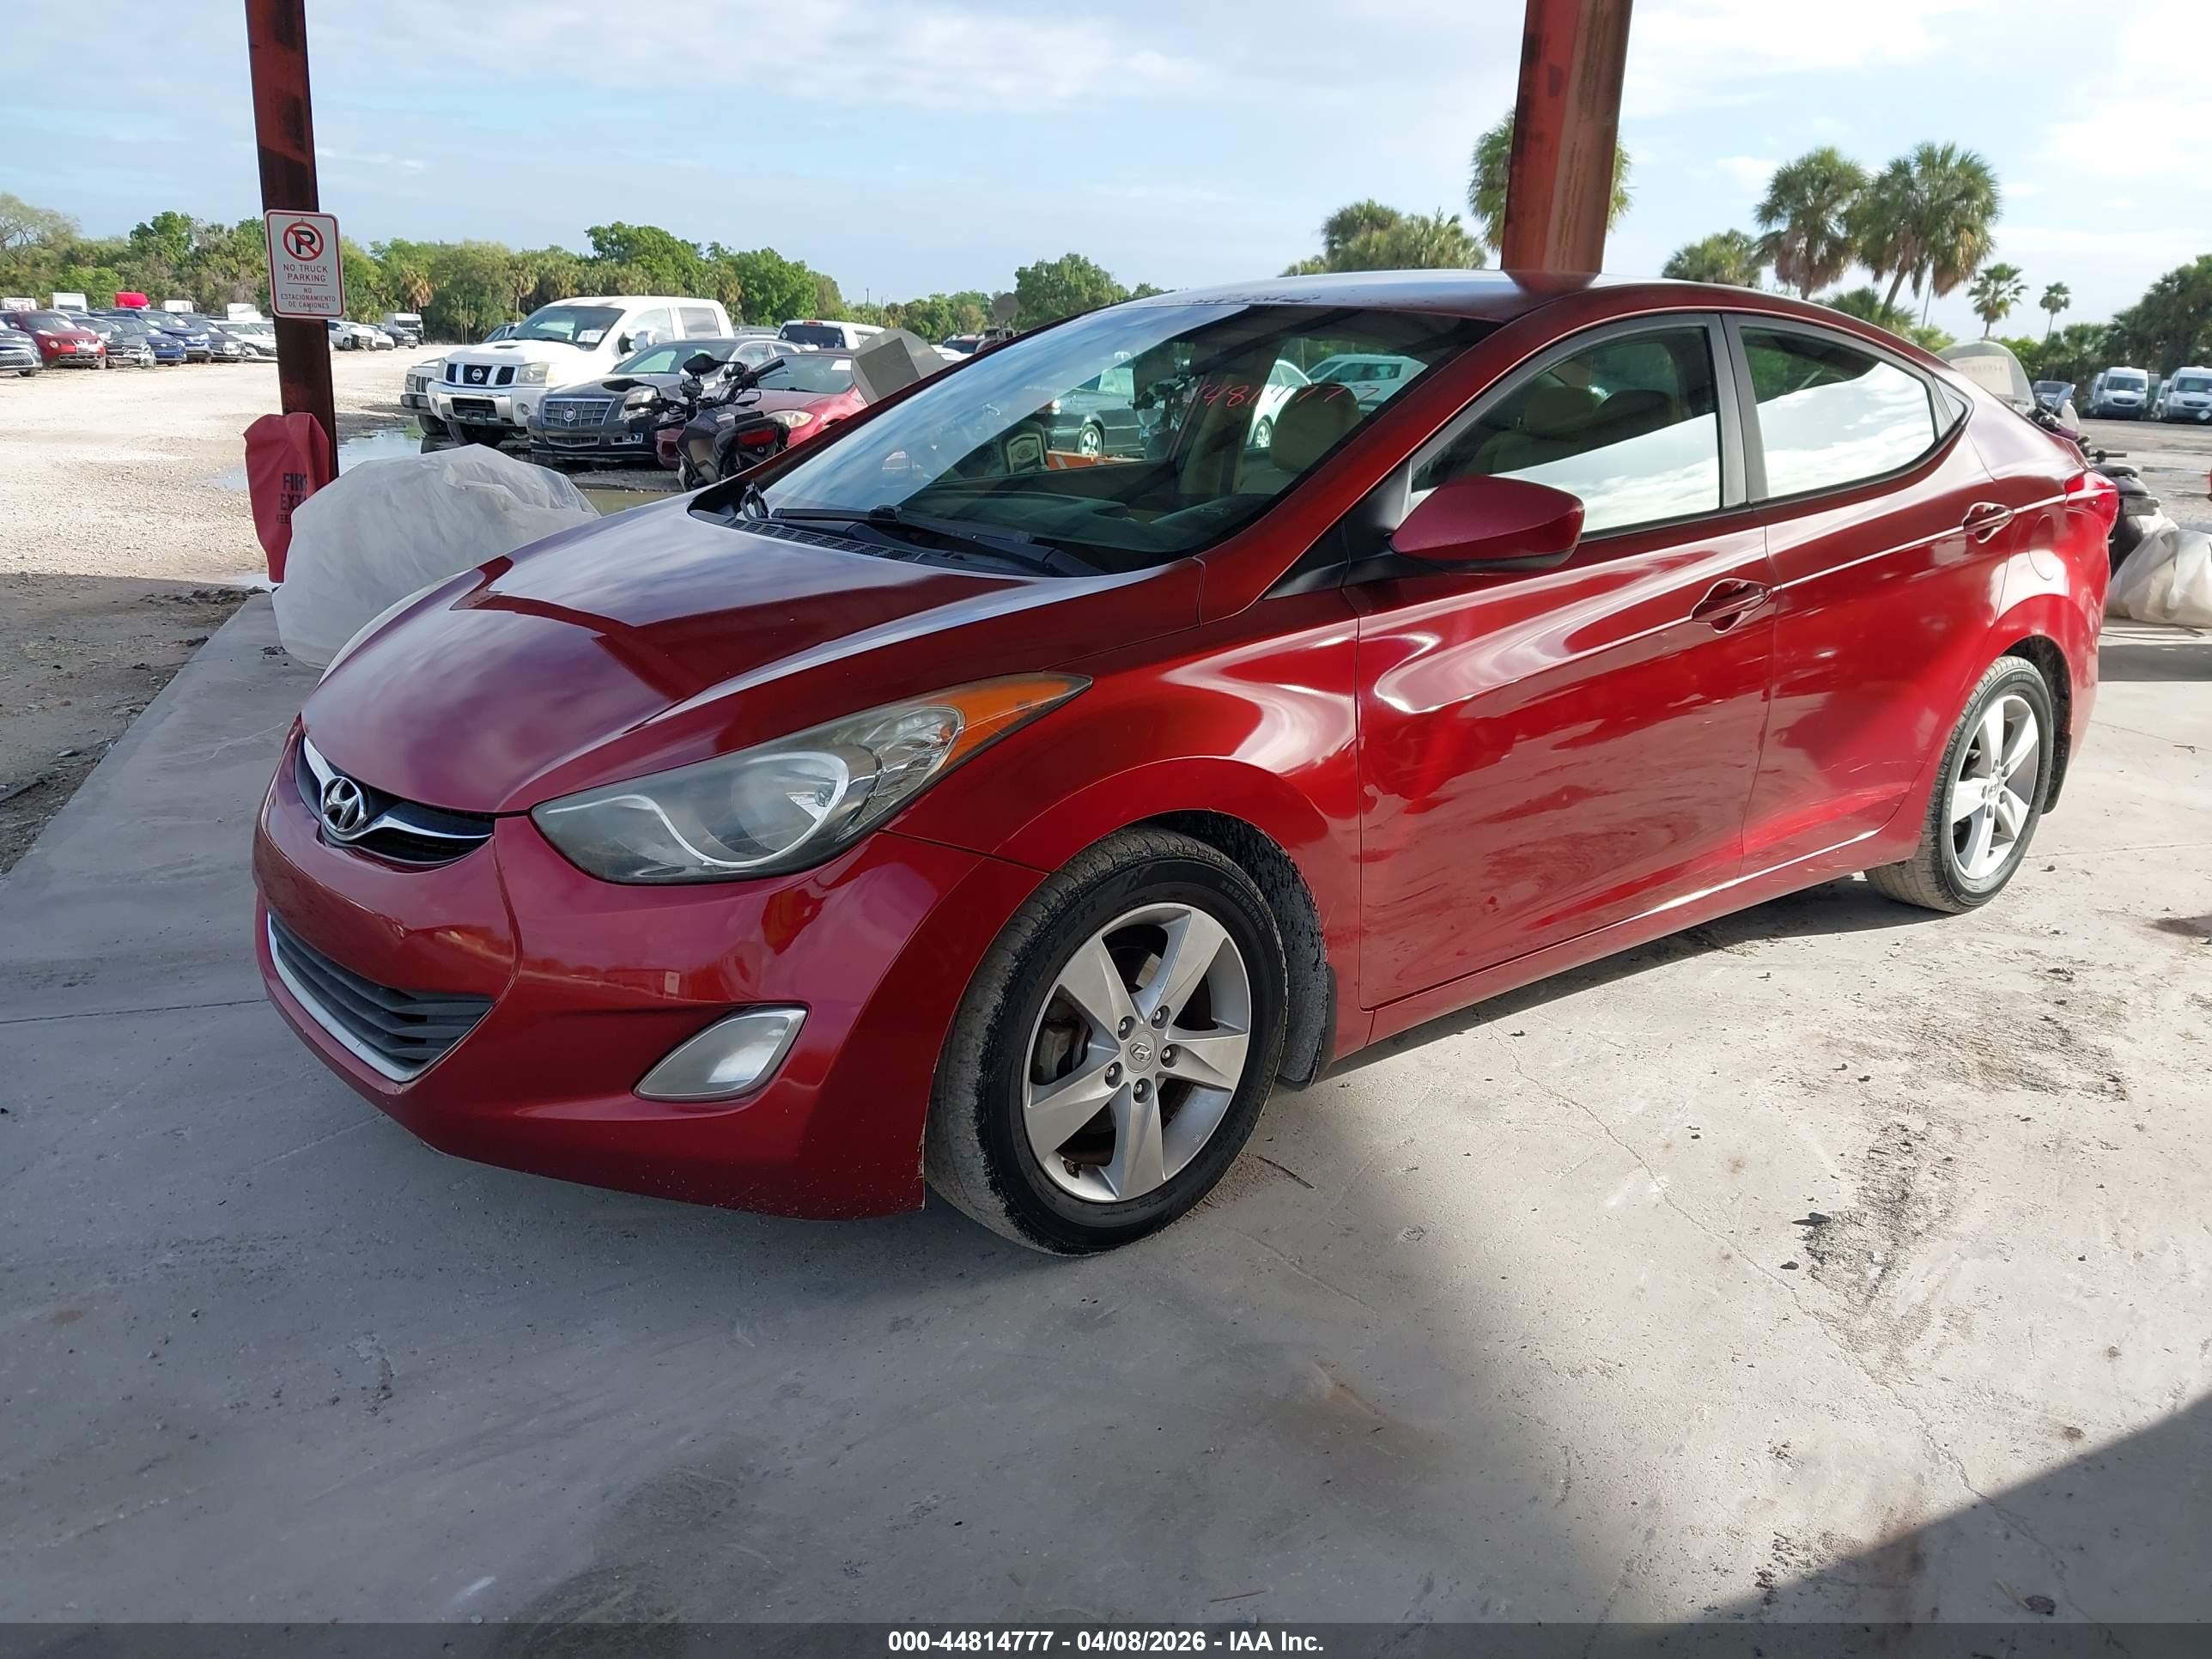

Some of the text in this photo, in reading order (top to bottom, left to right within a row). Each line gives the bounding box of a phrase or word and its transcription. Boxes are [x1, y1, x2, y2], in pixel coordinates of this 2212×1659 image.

[299, 264, 328, 273] TRUCK
[287, 273, 326, 283] PARKING
[280, 293, 336, 302] ESTACIONAMIENTO
